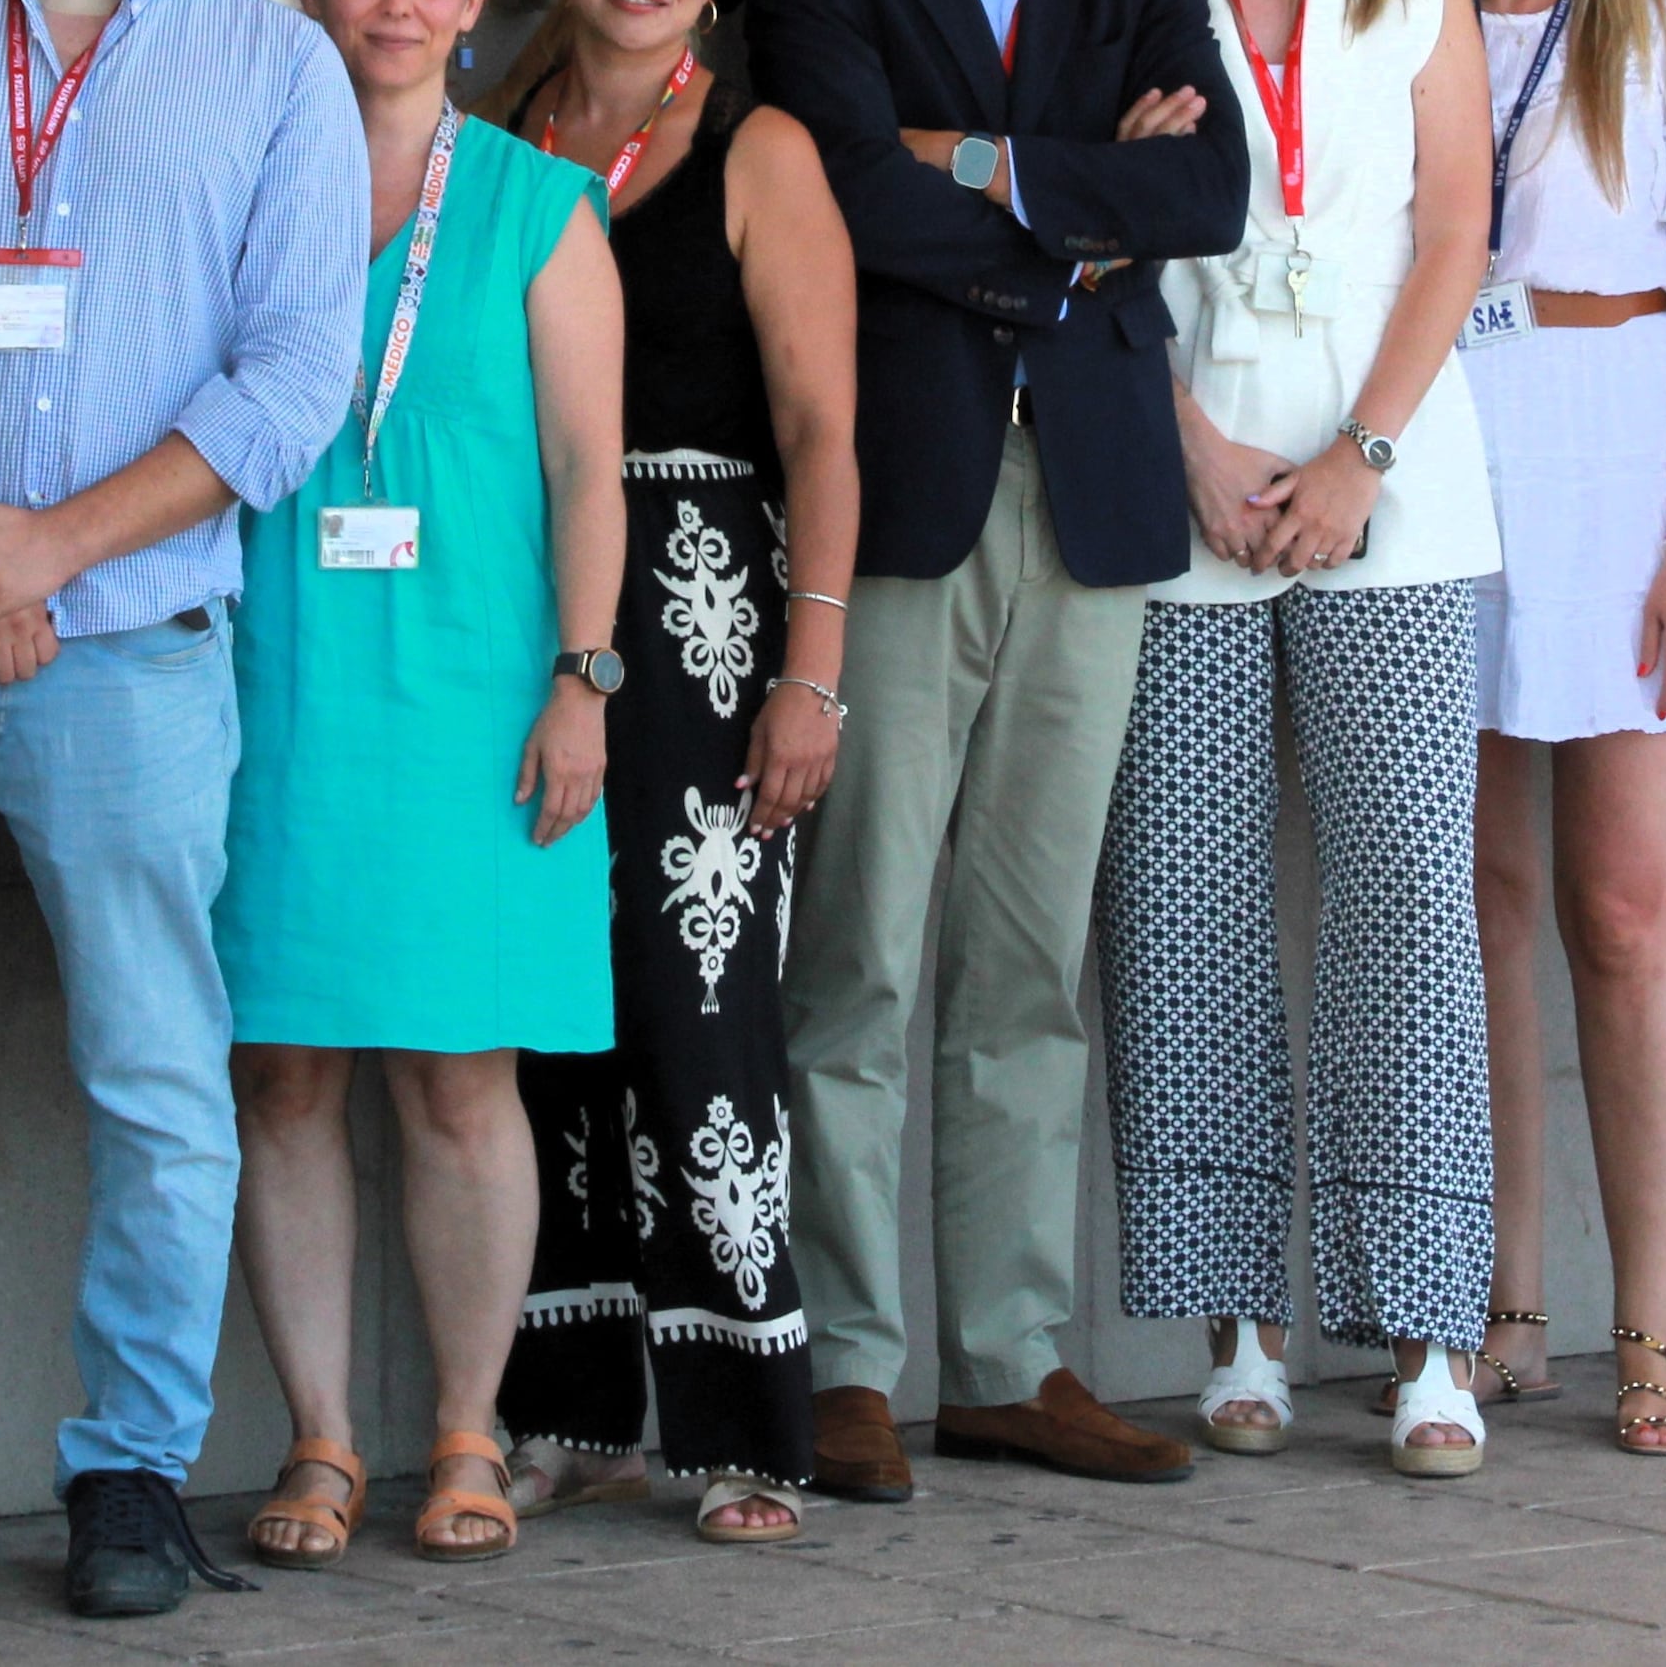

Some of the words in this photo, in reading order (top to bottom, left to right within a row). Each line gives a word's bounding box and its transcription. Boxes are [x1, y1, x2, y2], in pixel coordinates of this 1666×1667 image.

[13, 73, 25, 128] UNIVERSITAS
[46, 78, 76, 135] UNIVERSITAS
[424, 154, 447, 208] MÉDICO
[384, 319, 409, 385] MÉDICO
